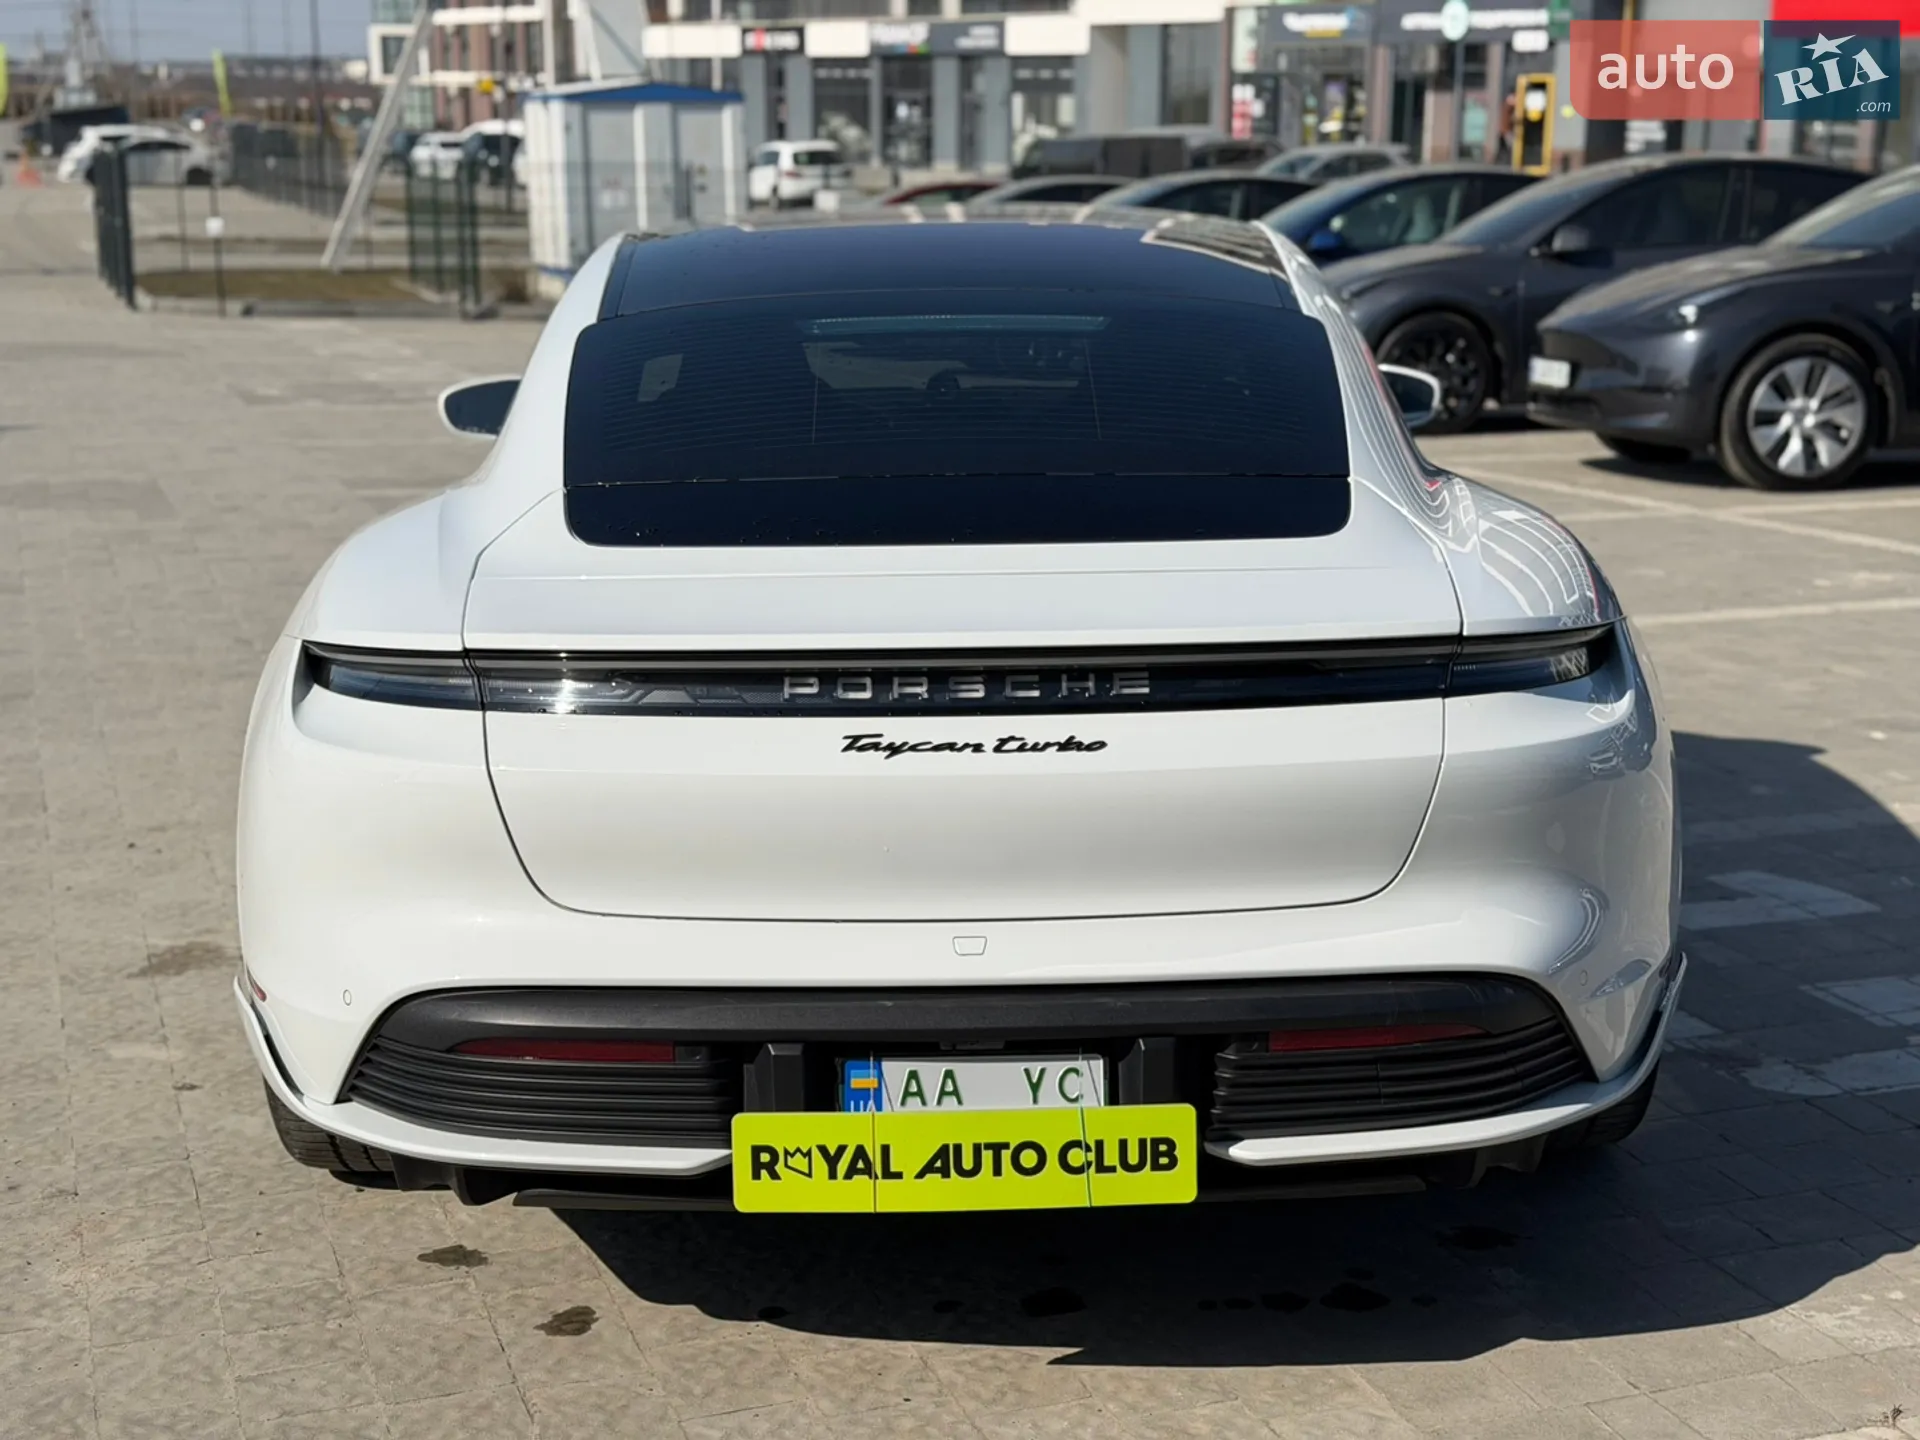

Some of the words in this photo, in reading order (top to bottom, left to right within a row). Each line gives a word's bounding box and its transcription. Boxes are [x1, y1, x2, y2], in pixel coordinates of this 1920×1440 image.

[782, 670, 1151, 701] PORSCHE
[840, 733, 986, 760] Taycan
[992, 734, 1109, 754] turbo
[899, 1067, 964, 1107] AA
[1023, 1066, 1085, 1105] YC
[750, 1144, 904, 1181] RYAL
[914, 1140, 1048, 1180] AUTO
[1057, 1136, 1179, 1176] CLUB
